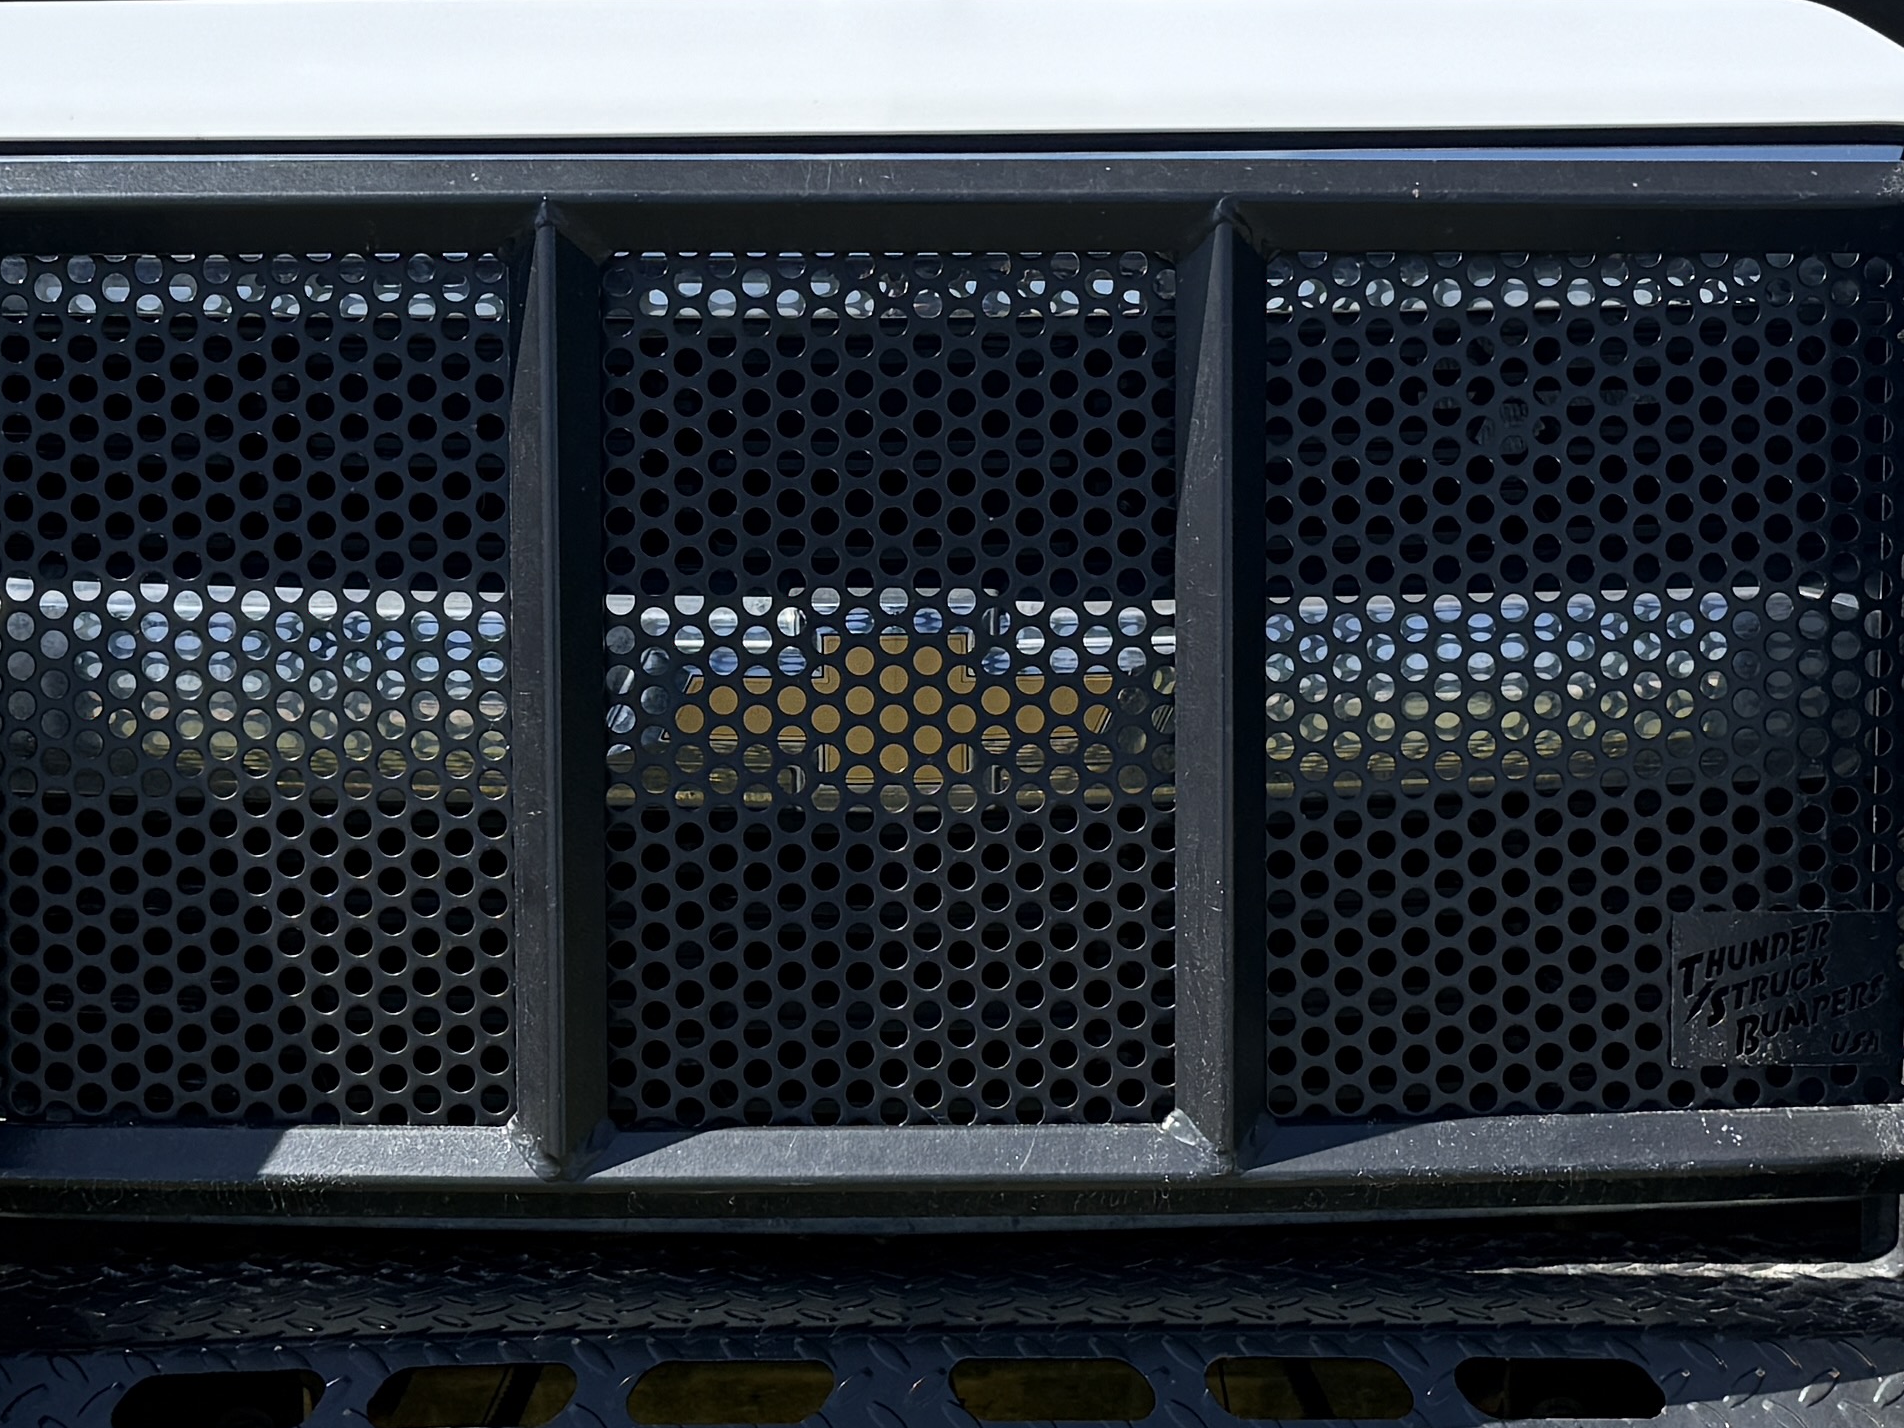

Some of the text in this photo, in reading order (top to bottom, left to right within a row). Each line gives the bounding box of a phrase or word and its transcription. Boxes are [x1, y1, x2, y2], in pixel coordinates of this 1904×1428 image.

[1678, 919, 1831, 999] THUNDER
[1707, 956, 1828, 1027] STRUCK
[1736, 973, 1884, 1056] BUMPERS
[1831, 1029, 1882, 1055] USA
